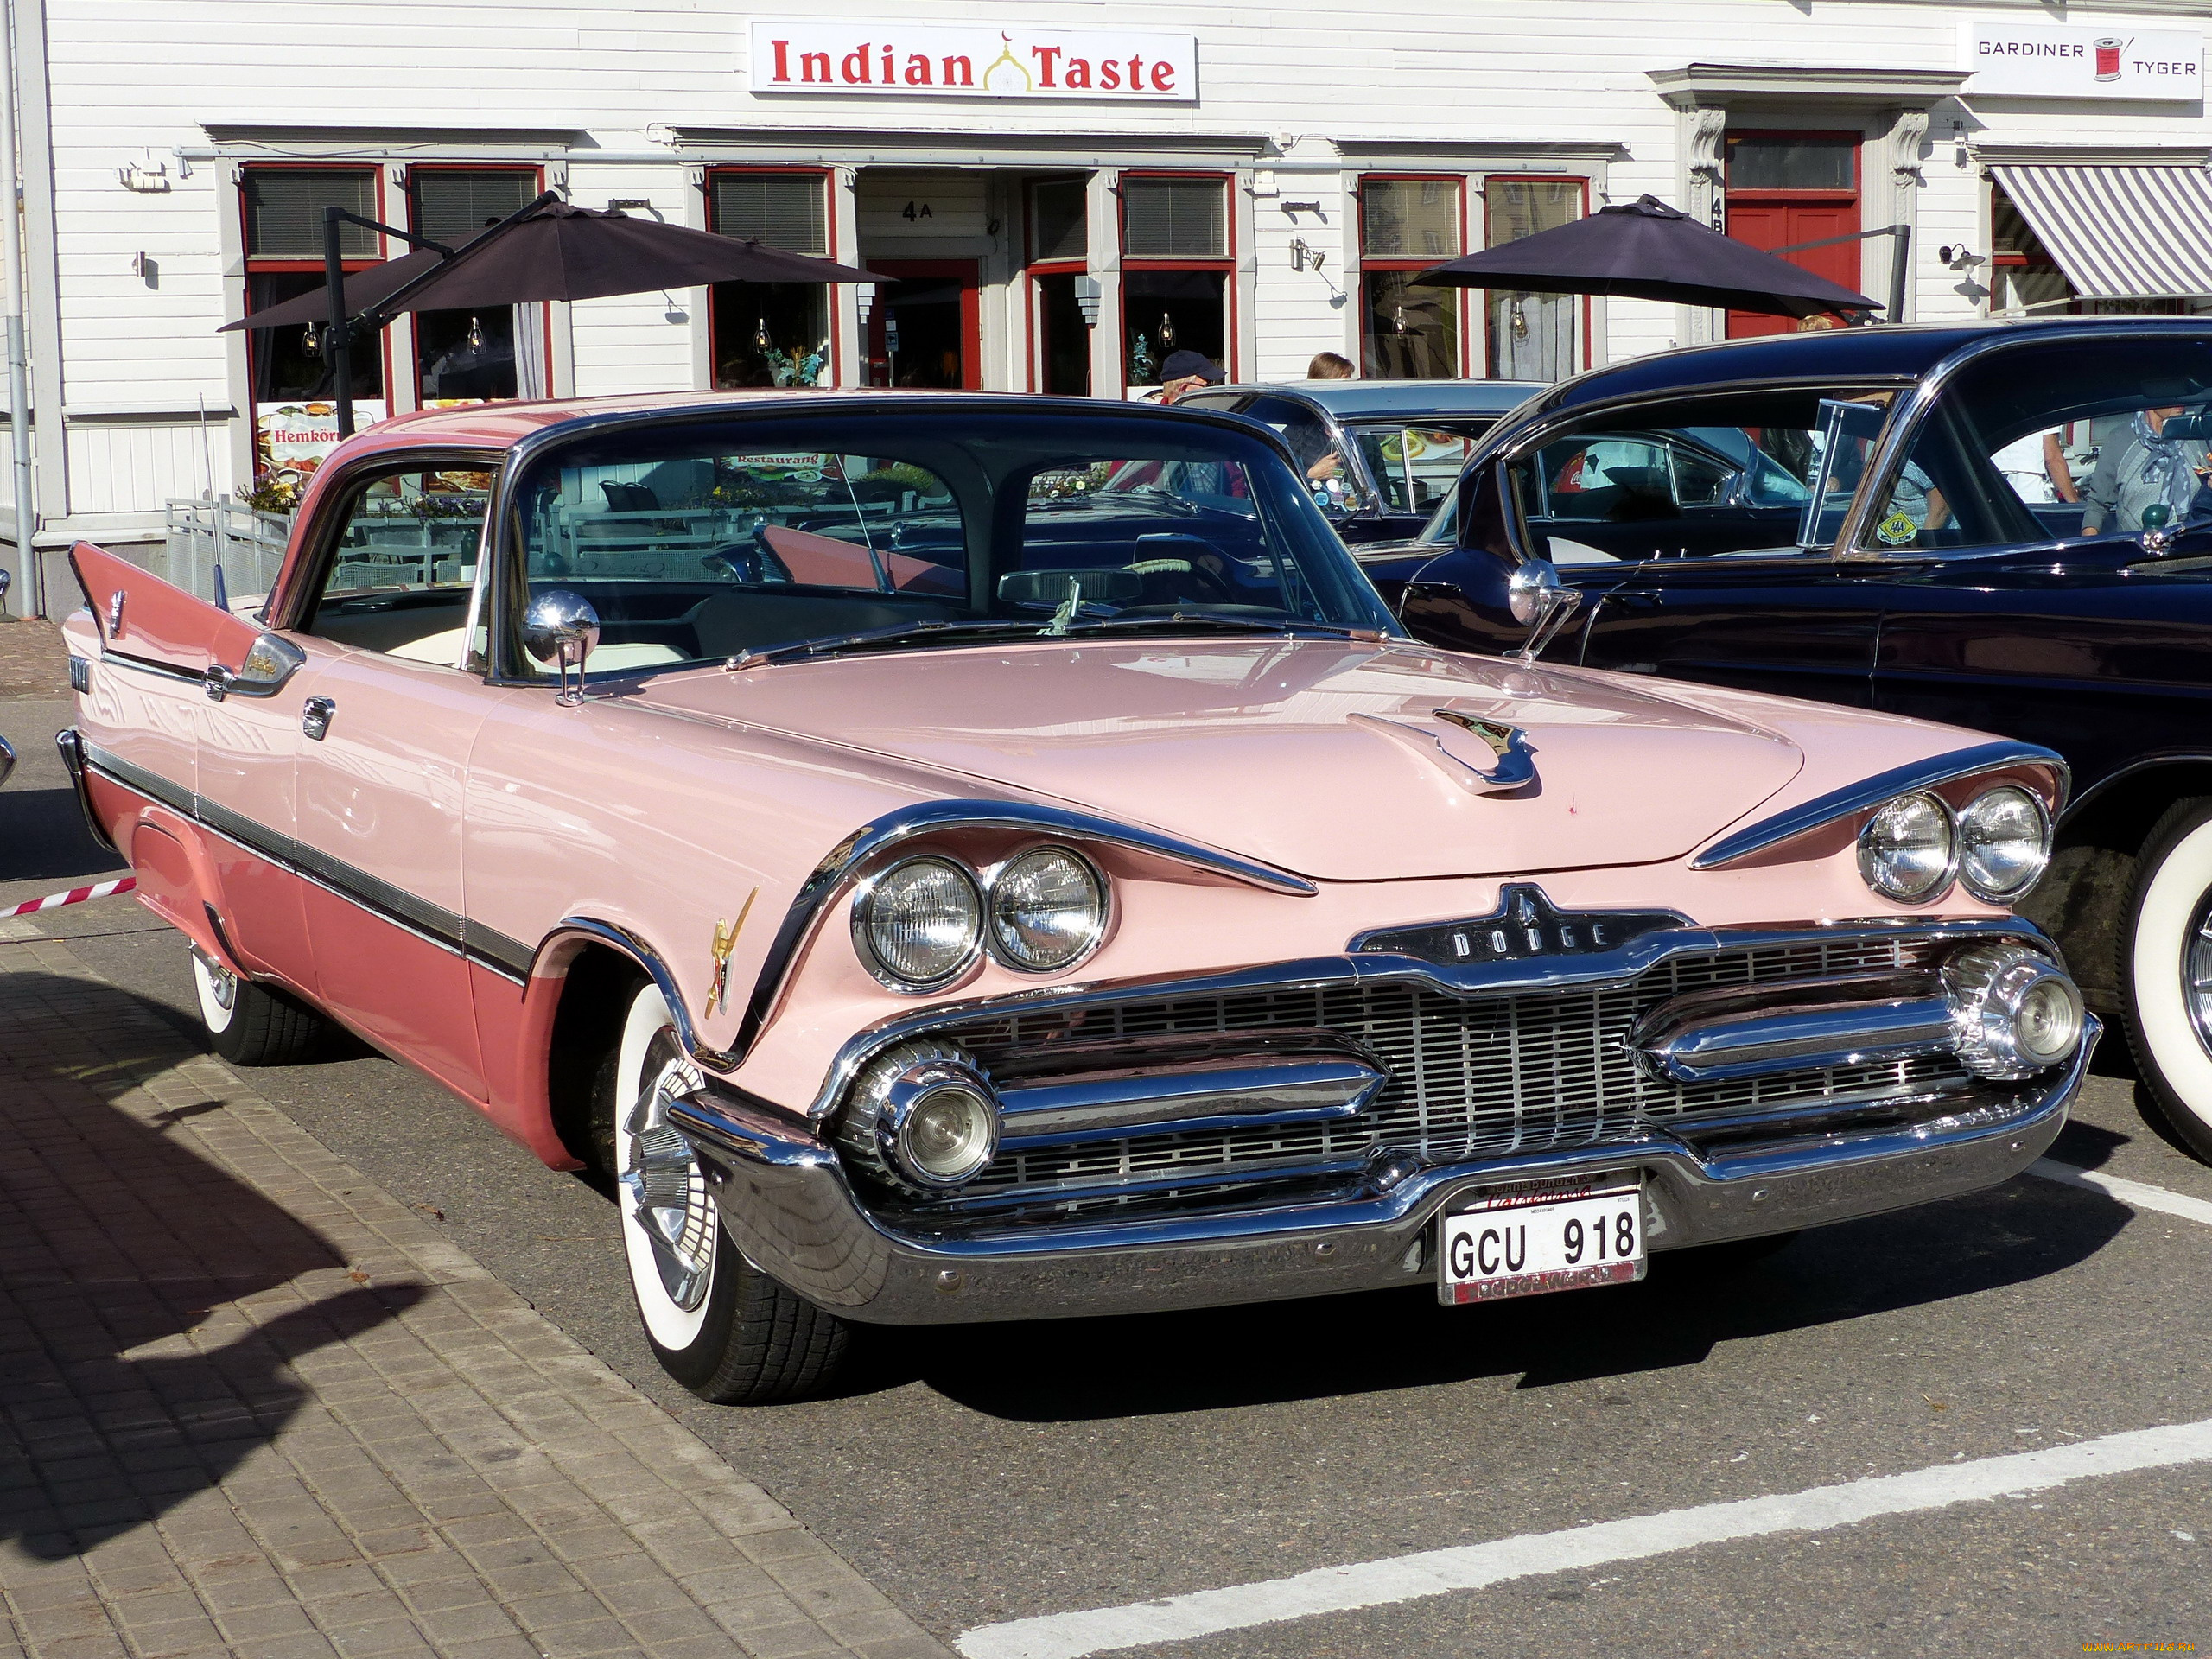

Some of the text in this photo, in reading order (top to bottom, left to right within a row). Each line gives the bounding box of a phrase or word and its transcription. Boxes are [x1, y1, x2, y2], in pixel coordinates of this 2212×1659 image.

[1979, 41, 2084, 58] GARDINER
[772, 40, 1176, 92] Indian Taste
[2133, 61, 2196, 75] TYGER
[737, 453, 820, 465] Restaurang
[1453, 924, 1608, 957] DODGE
[1450, 1211, 1635, 1280] GCU 918
